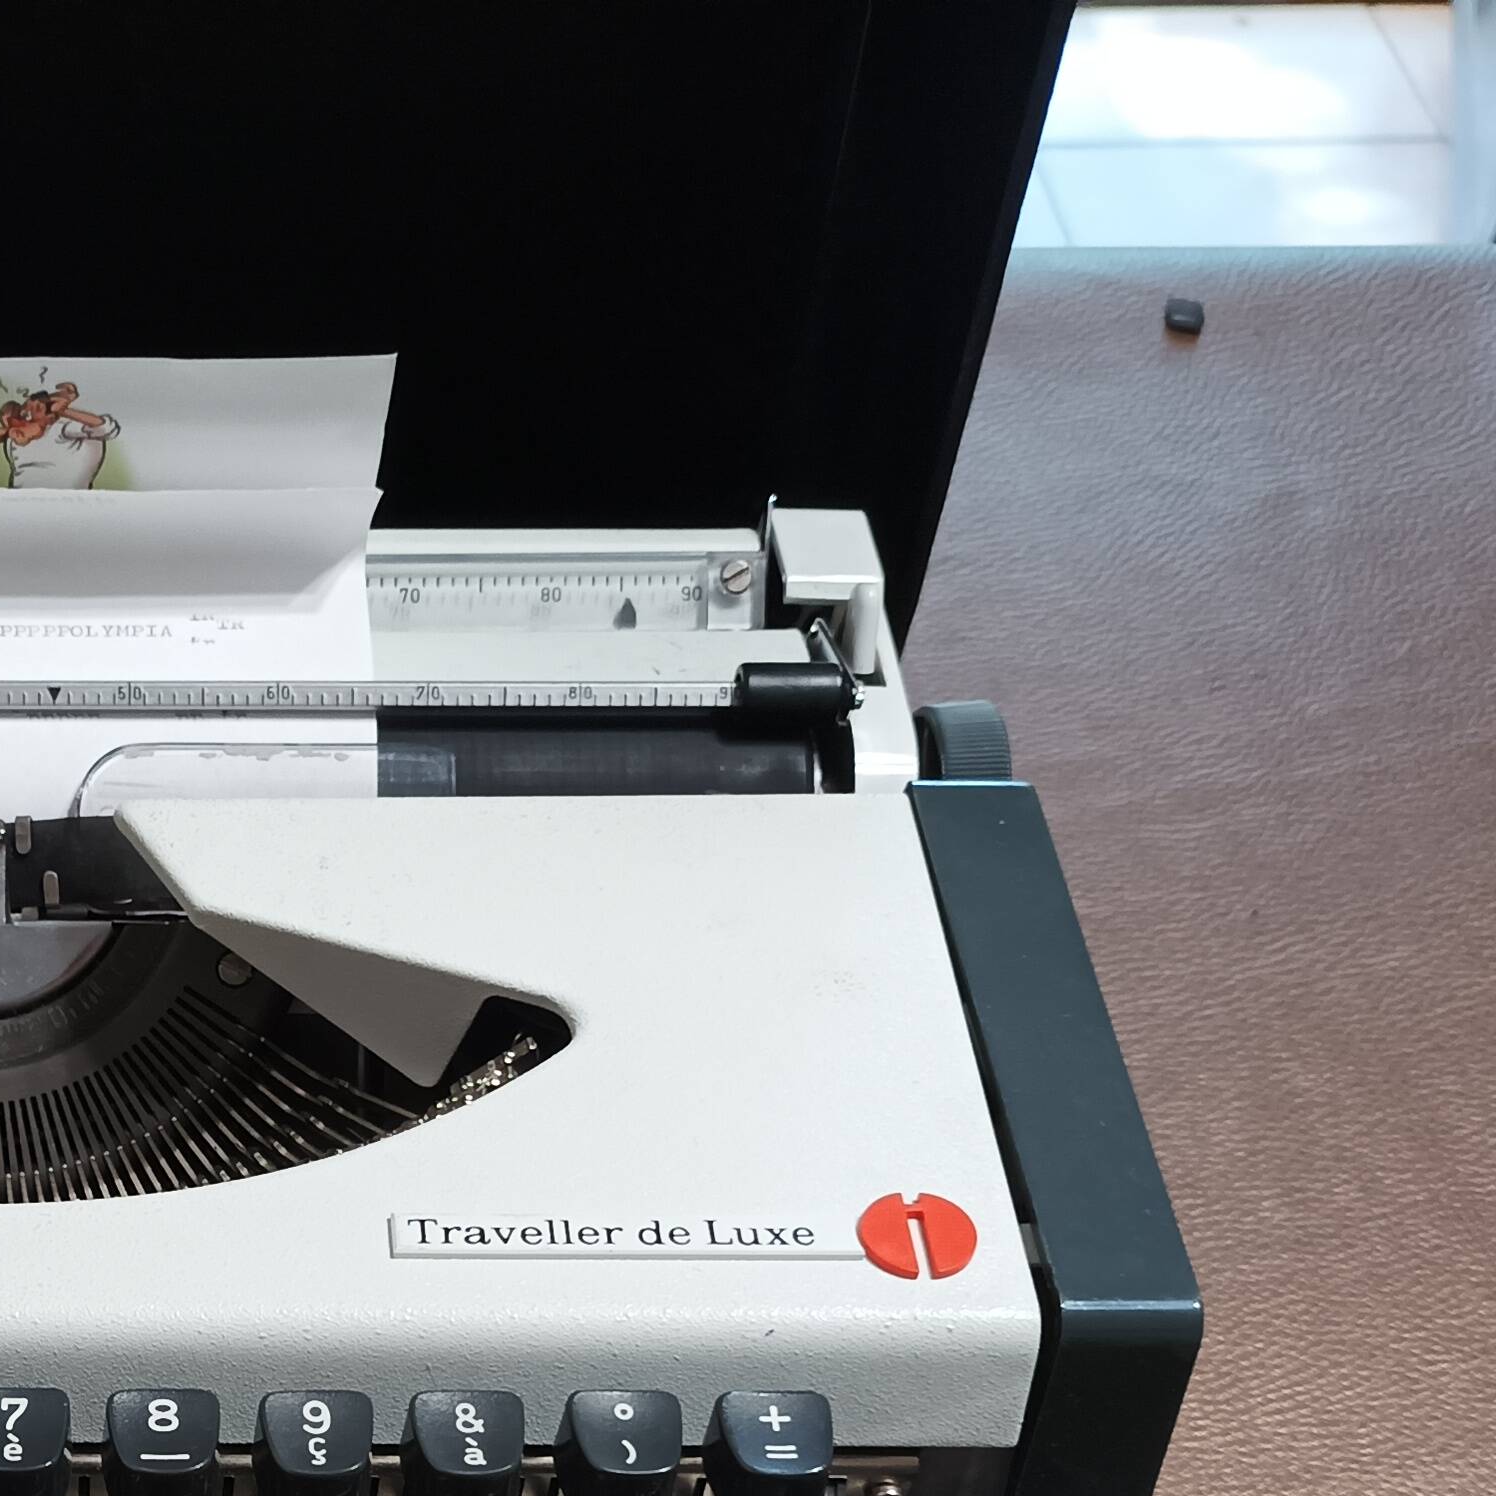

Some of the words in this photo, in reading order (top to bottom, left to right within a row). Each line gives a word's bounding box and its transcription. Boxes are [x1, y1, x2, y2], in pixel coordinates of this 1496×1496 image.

[399, 587, 421, 604] 70
[540, 587, 562, 604] 80
[681, 586, 703, 603] 90
[117, 685, 142, 701] 50
[266, 686, 291, 702] 60
[415, 686, 440, 702] 70
[569, 686, 593, 702] 80
[408, 1218, 623, 1246] Traveller
[637, 1220, 691, 1247] de
[703, 1218, 817, 1247] Luxe
[0, 1397, 29, 1431] 7
[147, 1398, 180, 1432] 8
[302, 1399, 331, 1435] 9
[448, 1399, 485, 1434] &
[3, 1432, 23, 1462] è
[308, 1437, 327, 1466] ç
[463, 1437, 488, 1466] à
